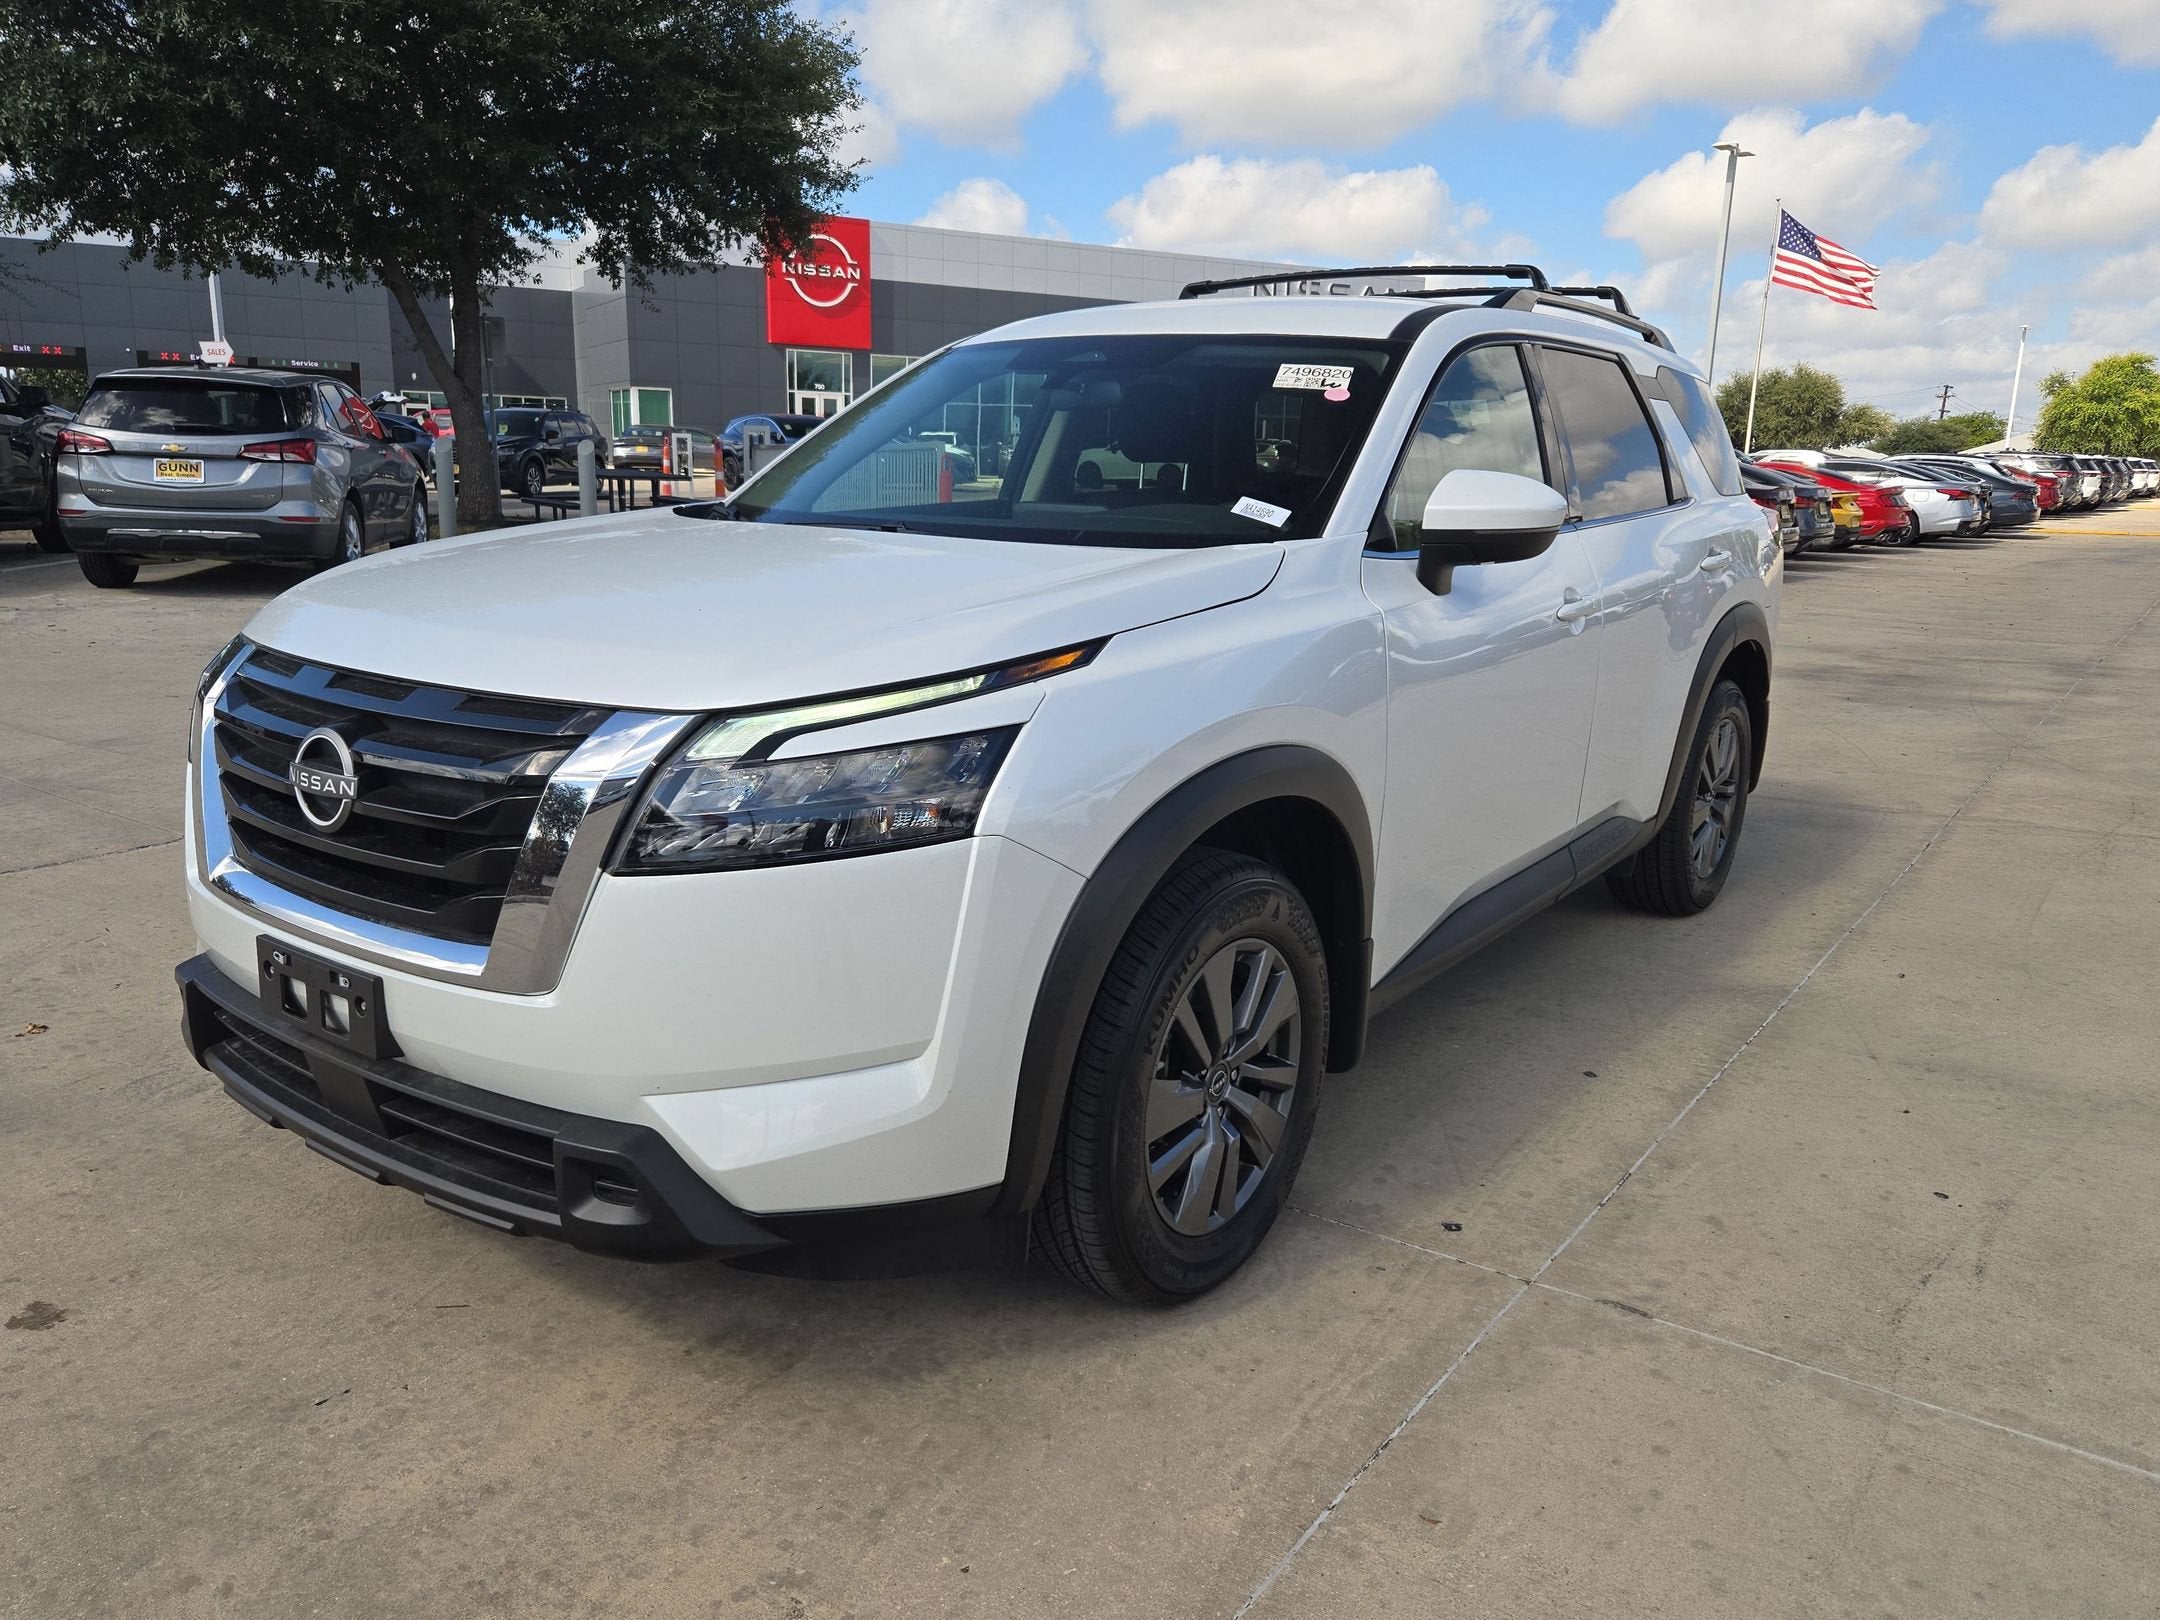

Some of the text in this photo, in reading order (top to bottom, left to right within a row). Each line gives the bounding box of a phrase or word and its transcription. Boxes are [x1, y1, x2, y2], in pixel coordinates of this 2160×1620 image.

[782, 262, 860, 279] NISSAN
[13, 344, 31, 352] Exit
[291, 359, 319, 367] Service
[1282, 367, 1352, 379] 7496820
[158, 463, 199, 473] GUNN
[289, 765, 355, 797] NISSAN
[1143, 944, 1200, 1056] KUMHO
